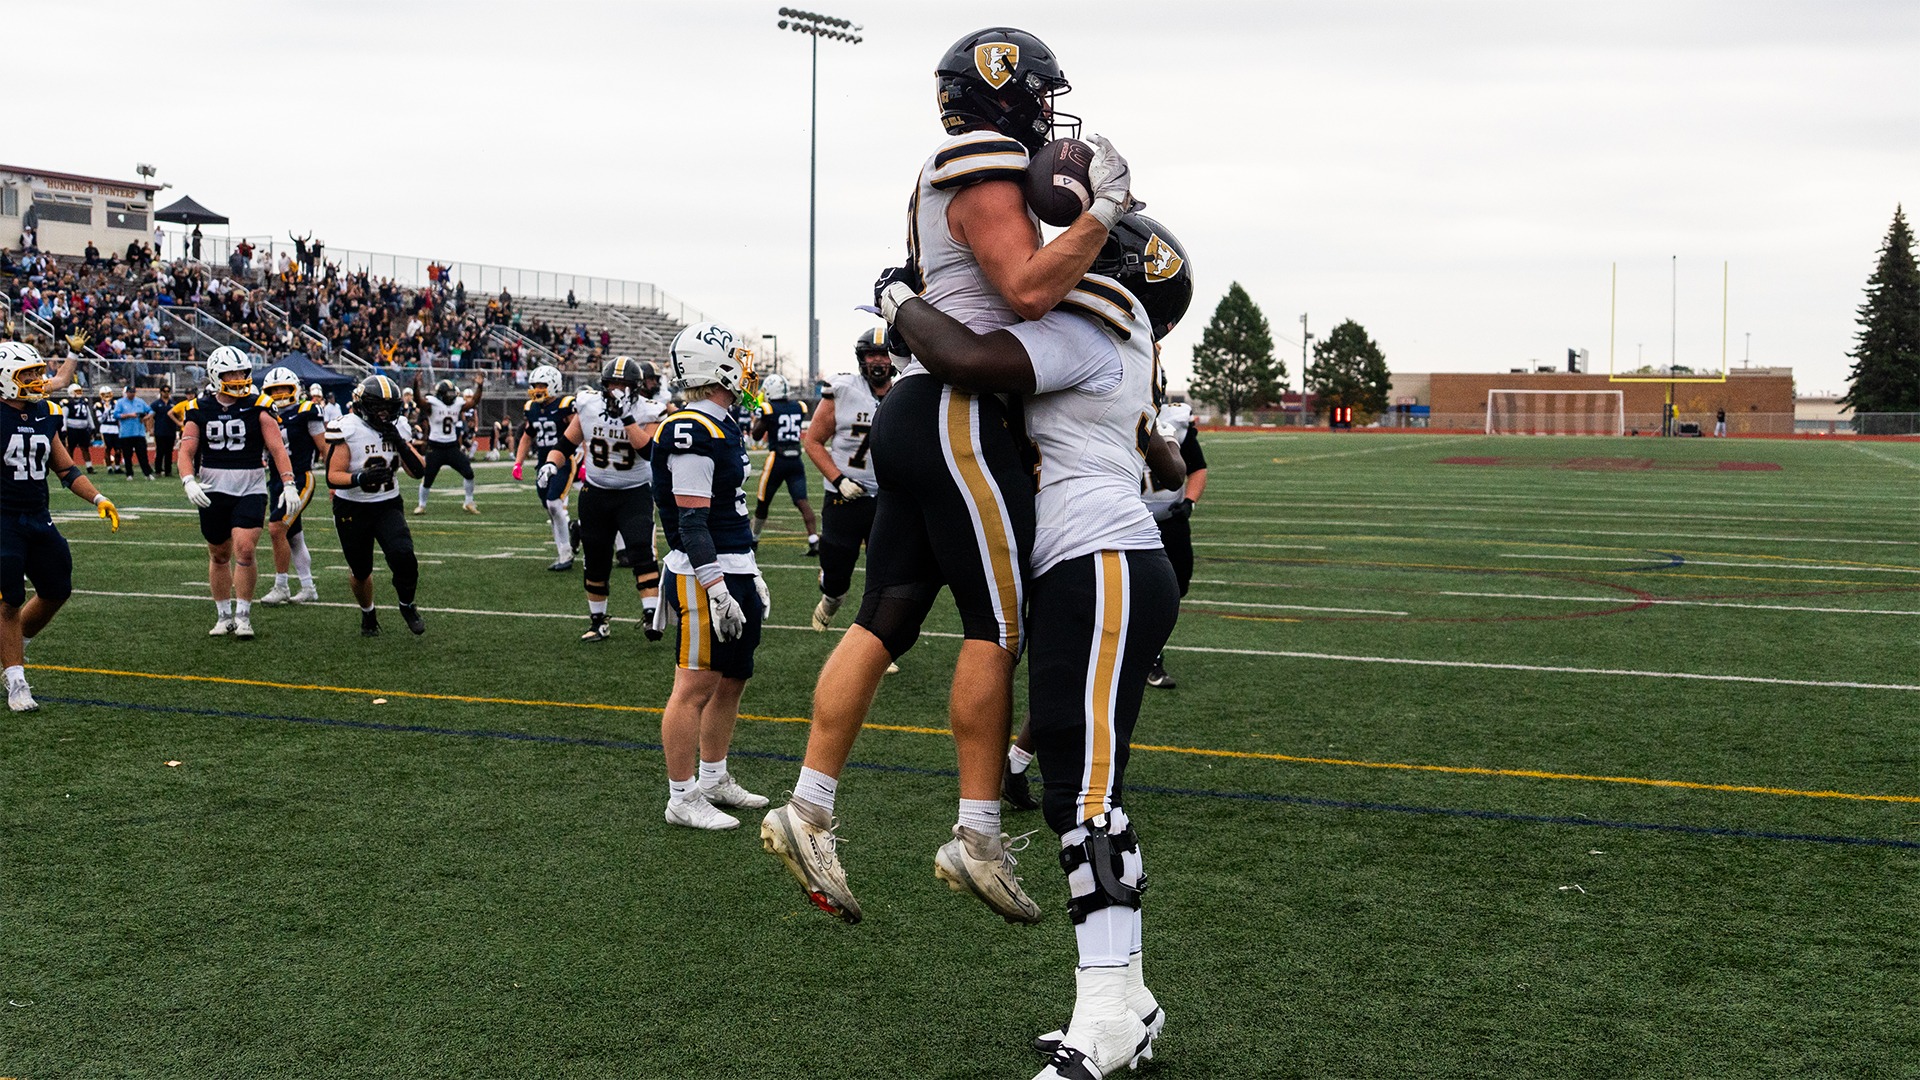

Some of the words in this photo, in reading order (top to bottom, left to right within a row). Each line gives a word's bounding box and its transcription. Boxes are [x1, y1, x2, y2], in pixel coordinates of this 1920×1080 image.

[443, 416, 453, 434] 6
[777, 414, 801, 441] 25
[857, 412, 871, 423] ST.
[206, 419, 246, 451] 98
[532, 420, 558, 447] 22
[593, 427, 605, 437] ST.
[674, 423, 693, 449] 5
[4, 434, 51, 480] 40
[365, 444, 378, 454] ST.
[382, 443, 397, 452] OL
[590, 437, 635, 471] 93
